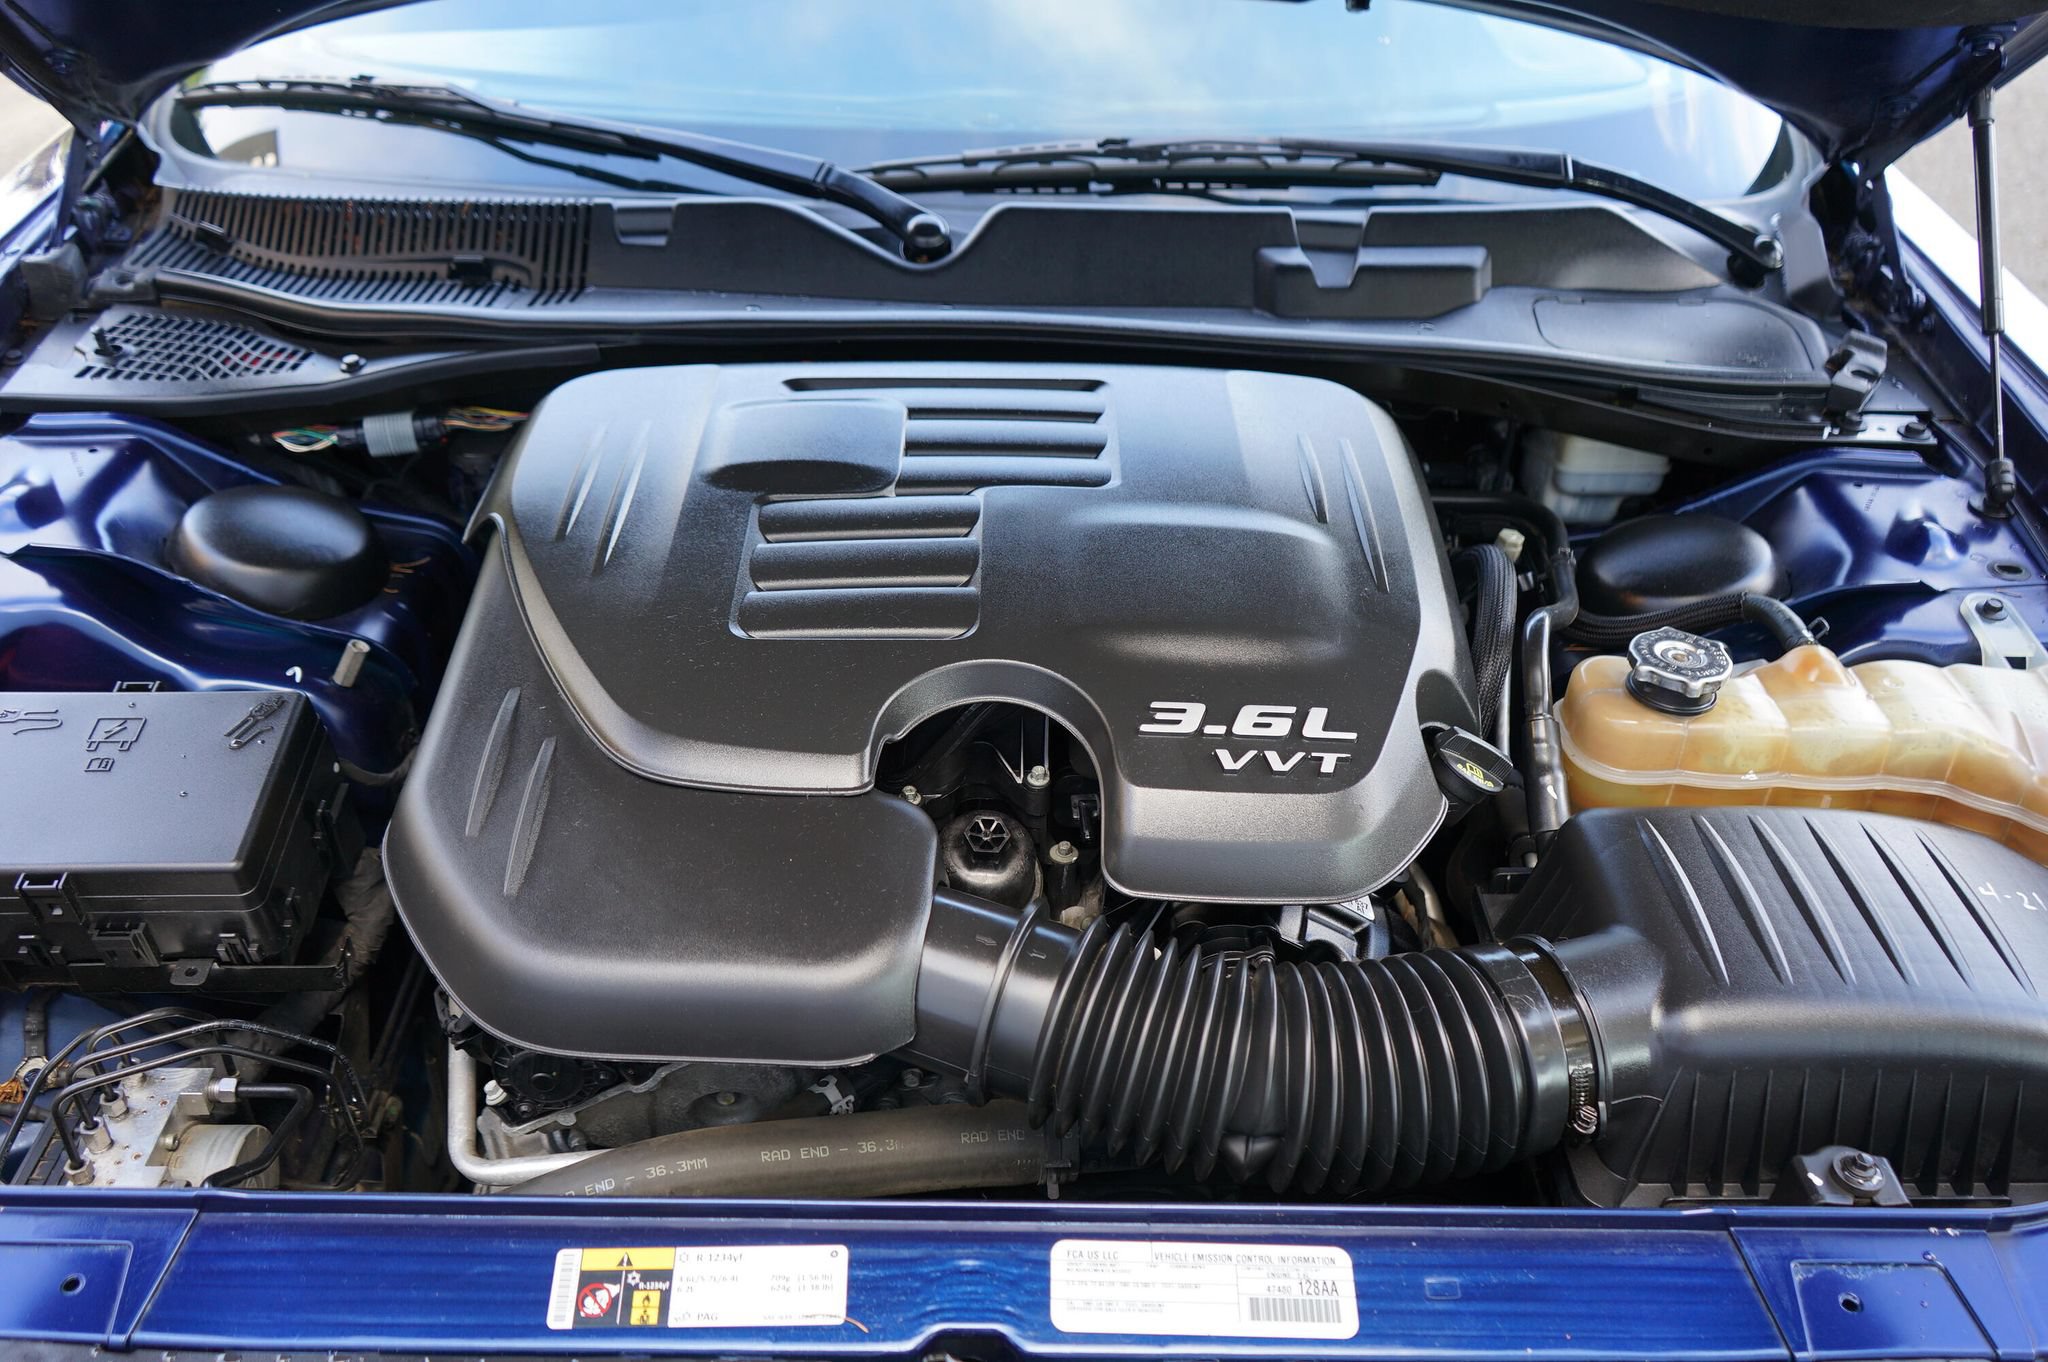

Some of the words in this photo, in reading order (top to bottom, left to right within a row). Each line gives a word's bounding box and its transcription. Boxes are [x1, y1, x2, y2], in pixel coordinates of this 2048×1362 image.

[1138, 701, 1359, 742] 3.6L
[1214, 749, 1352, 776] VVT
[960, 1131, 989, 1145] RAD
[997, 1129, 1025, 1142] END
[760, 1149, 792, 1163] RAD
[800, 1145, 830, 1160] END
[584, 1178, 616, 1197] END
[645, 1157, 709, 1180] 36.3MM
[1066, 1249, 1084, 1260] FCA
[1086, 1250, 1100, 1261] US
[1102, 1250, 1119, 1261] LLC
[1154, 1252, 1188, 1263] VEHICLE
[1191, 1253, 1234, 1264] EMISSION
[1235, 1254, 1275, 1265] CONTROL
[1277, 1254, 1337, 1266] INFORMATION
[1298, 1279, 1340, 1297] 128AA
[697, 1312, 719, 1322] PAG
